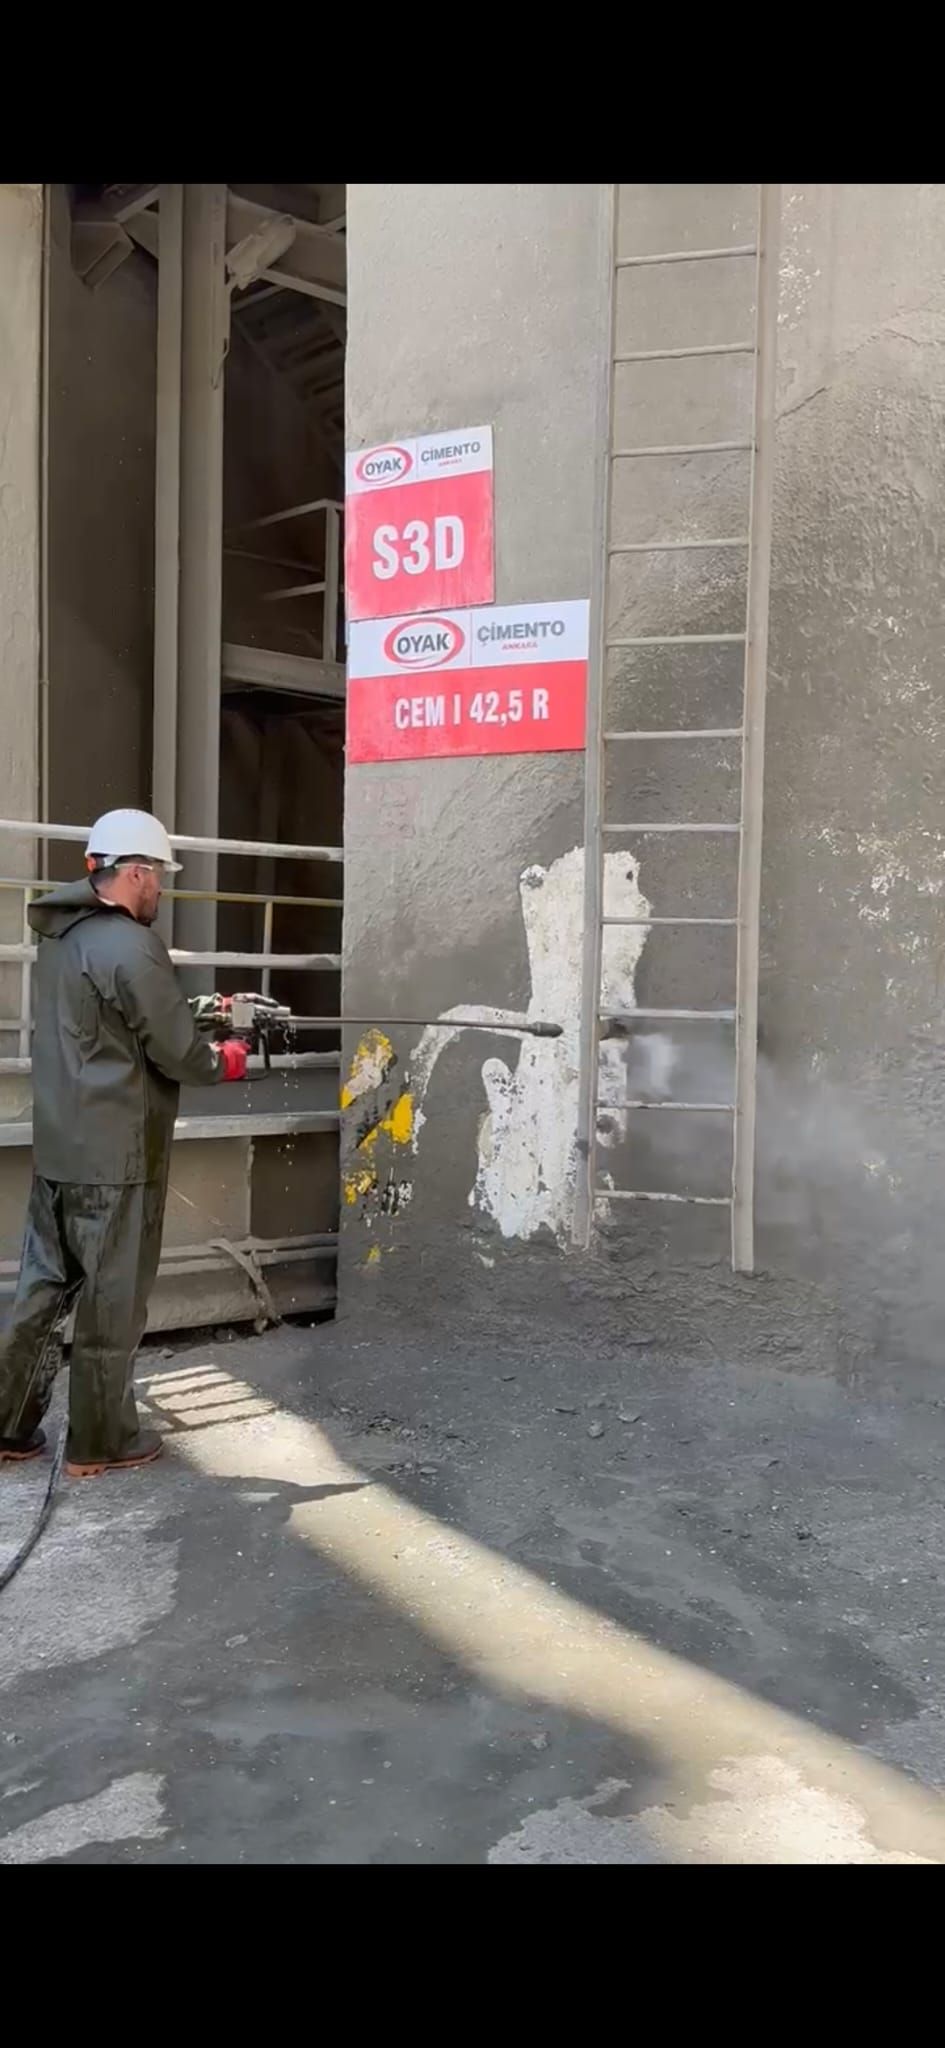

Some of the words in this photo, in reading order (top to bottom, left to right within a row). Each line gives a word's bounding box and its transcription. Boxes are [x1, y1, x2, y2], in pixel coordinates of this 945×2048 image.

[421, 441, 481, 464] ÇİMENTO
[365, 457, 403, 477] OYAK
[372, 515, 465, 581] S3D
[397, 632, 450, 655] OYAK
[477, 620, 565, 647] ÇİMENTO
[395, 695, 445, 729] CEM
[454, 695, 460, 725] I
[469, 688, 523, 727] 42,5
[533, 688, 549, 720] R
